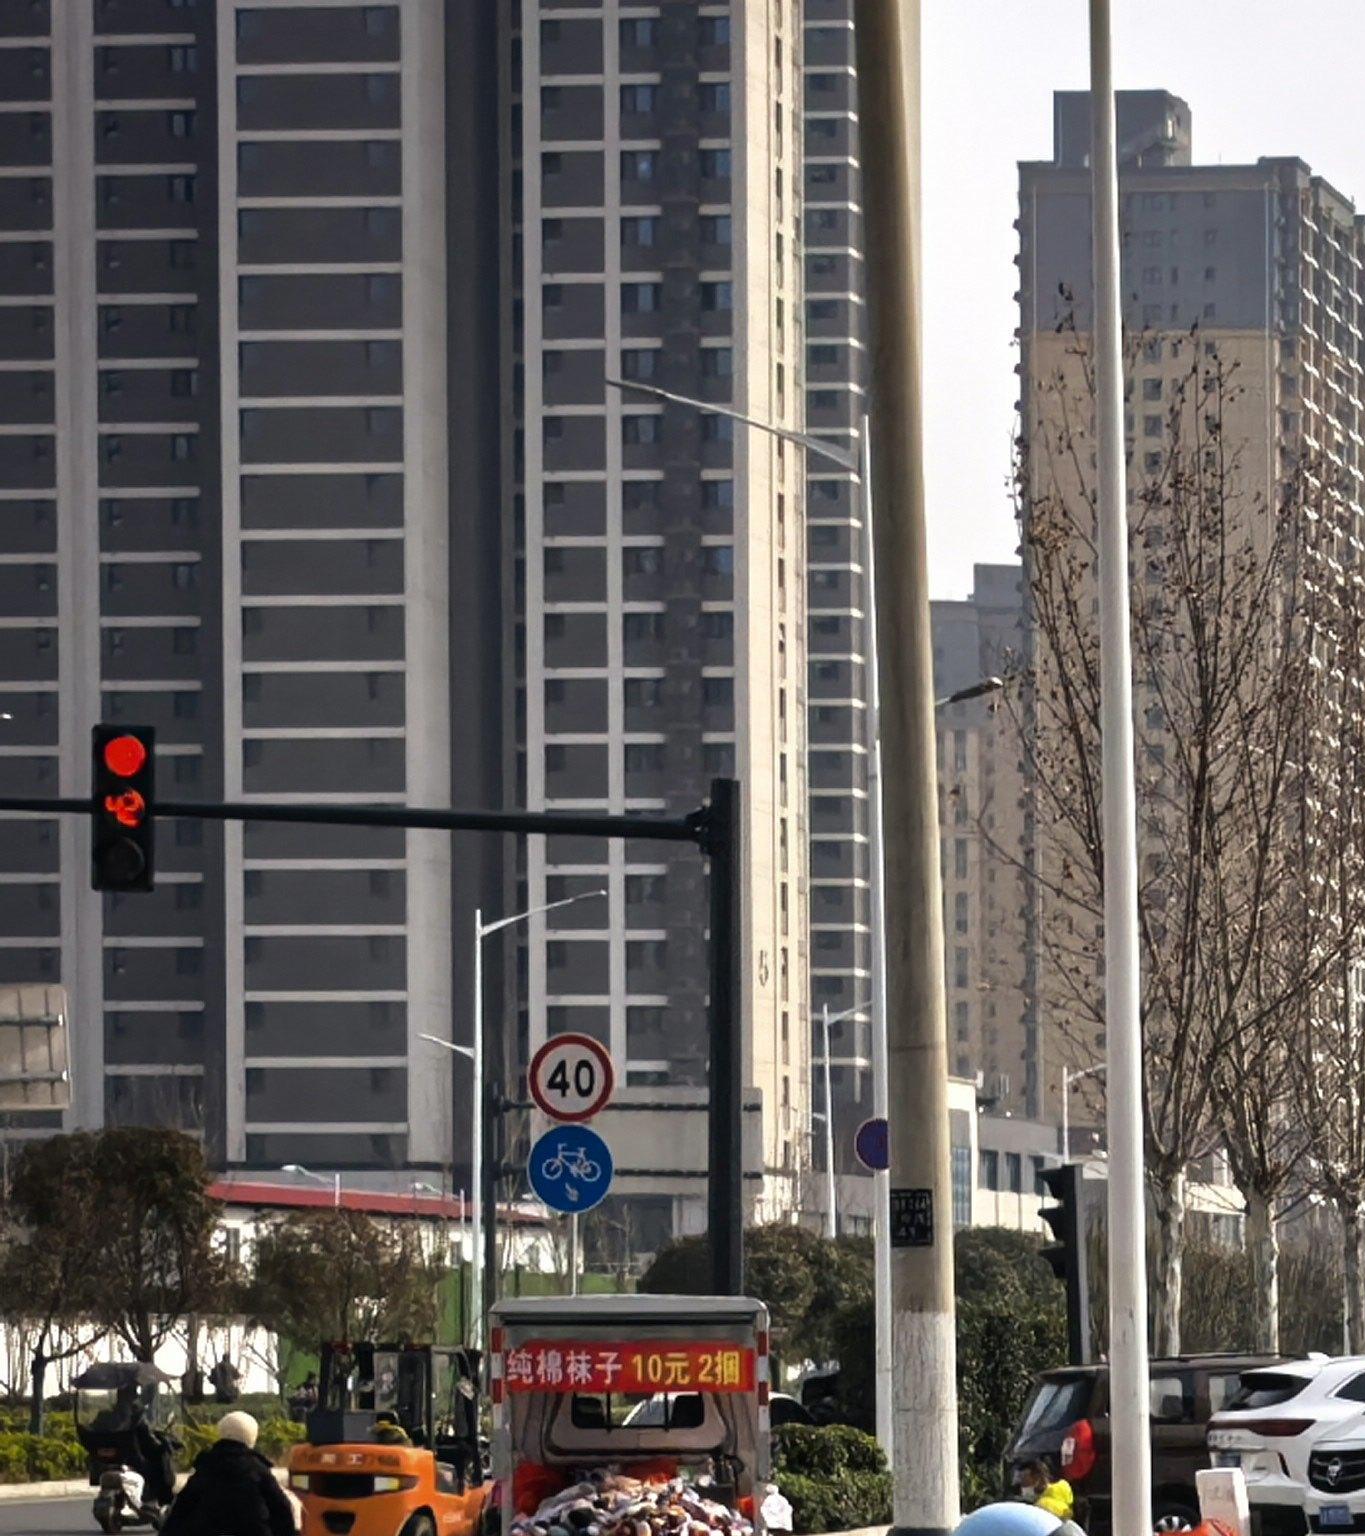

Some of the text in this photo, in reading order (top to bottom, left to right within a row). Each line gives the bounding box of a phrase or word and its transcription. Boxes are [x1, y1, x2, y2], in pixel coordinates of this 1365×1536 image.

[547, 1059, 595, 1098] 40
[507, 1348, 741, 1386] 纯棉袜子 10元 2捆
